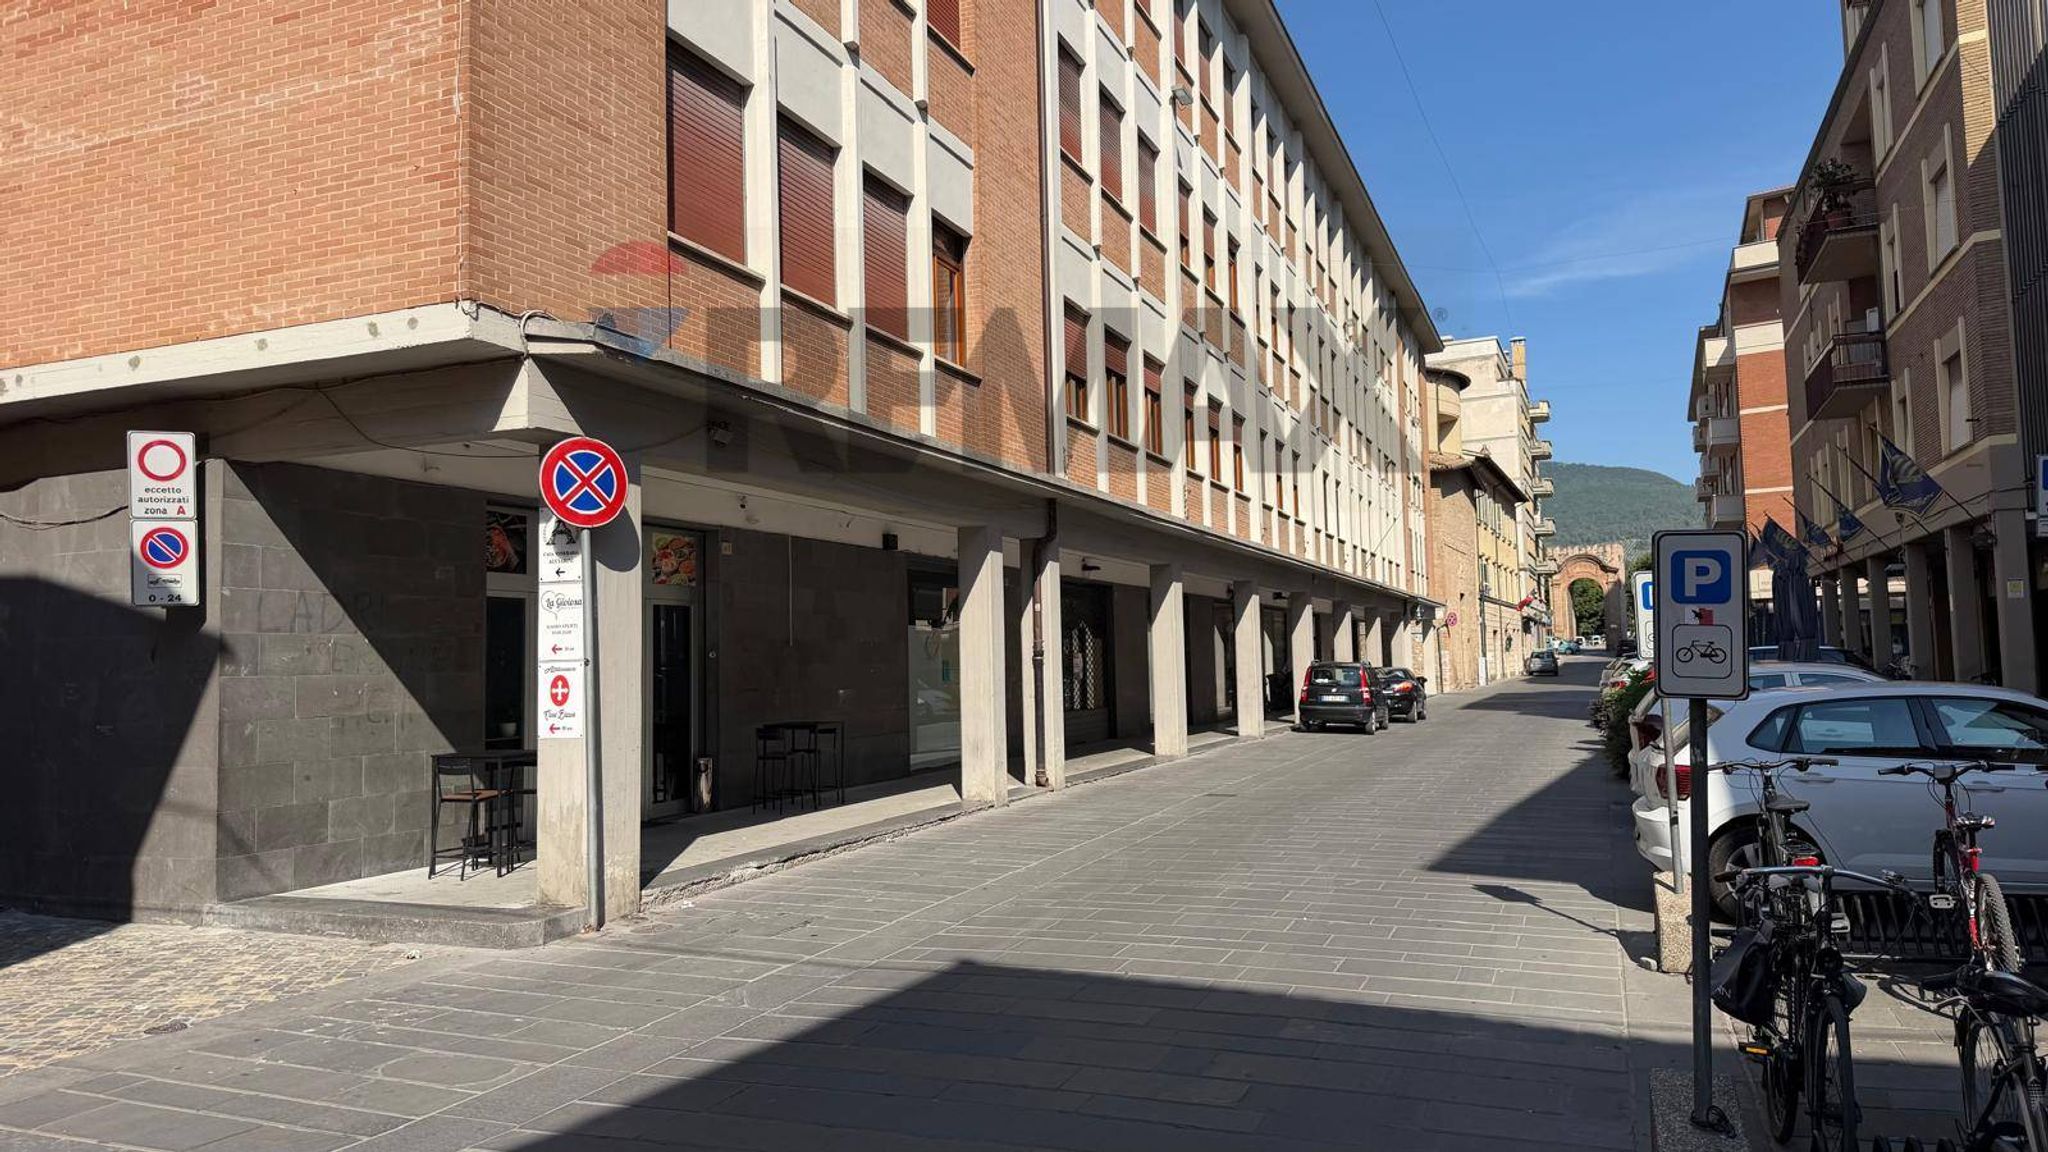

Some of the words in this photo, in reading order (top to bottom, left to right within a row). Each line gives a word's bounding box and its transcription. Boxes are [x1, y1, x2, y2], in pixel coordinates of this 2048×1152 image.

[144, 486, 182, 494] eccetto
[138, 496, 190, 504] autorizzati
[144, 507, 168, 515] zona
[176, 505, 186, 515] A
[1684, 557, 1722, 597] P
[148, 594, 157, 602] 0
[167, 594, 182, 602] 24
